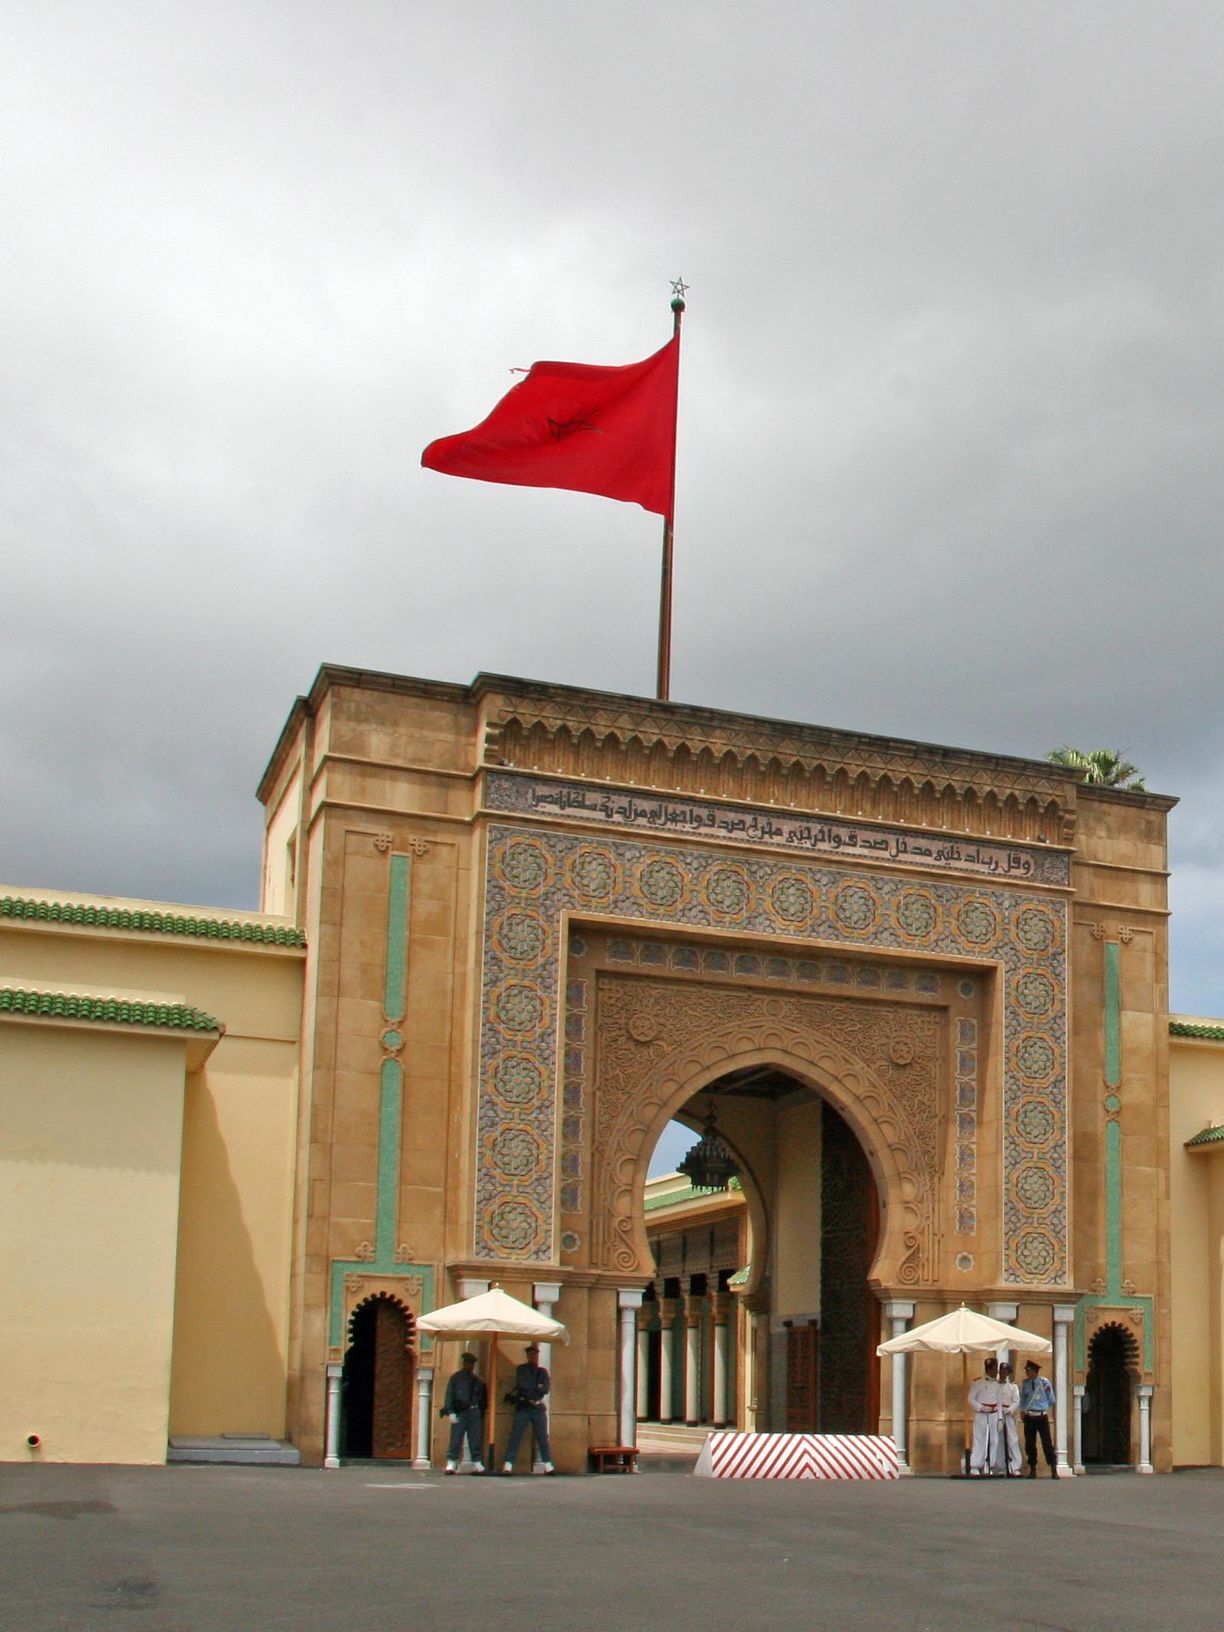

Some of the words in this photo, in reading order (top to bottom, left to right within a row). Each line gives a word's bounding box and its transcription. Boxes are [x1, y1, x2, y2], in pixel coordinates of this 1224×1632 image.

[704, 810, 745, 833] صدق
[842, 831, 889, 851] صدق
[889, 837, 933, 858] مدخل
[980, 855, 999, 872] رب
[1000, 850, 1031, 875] وقل
